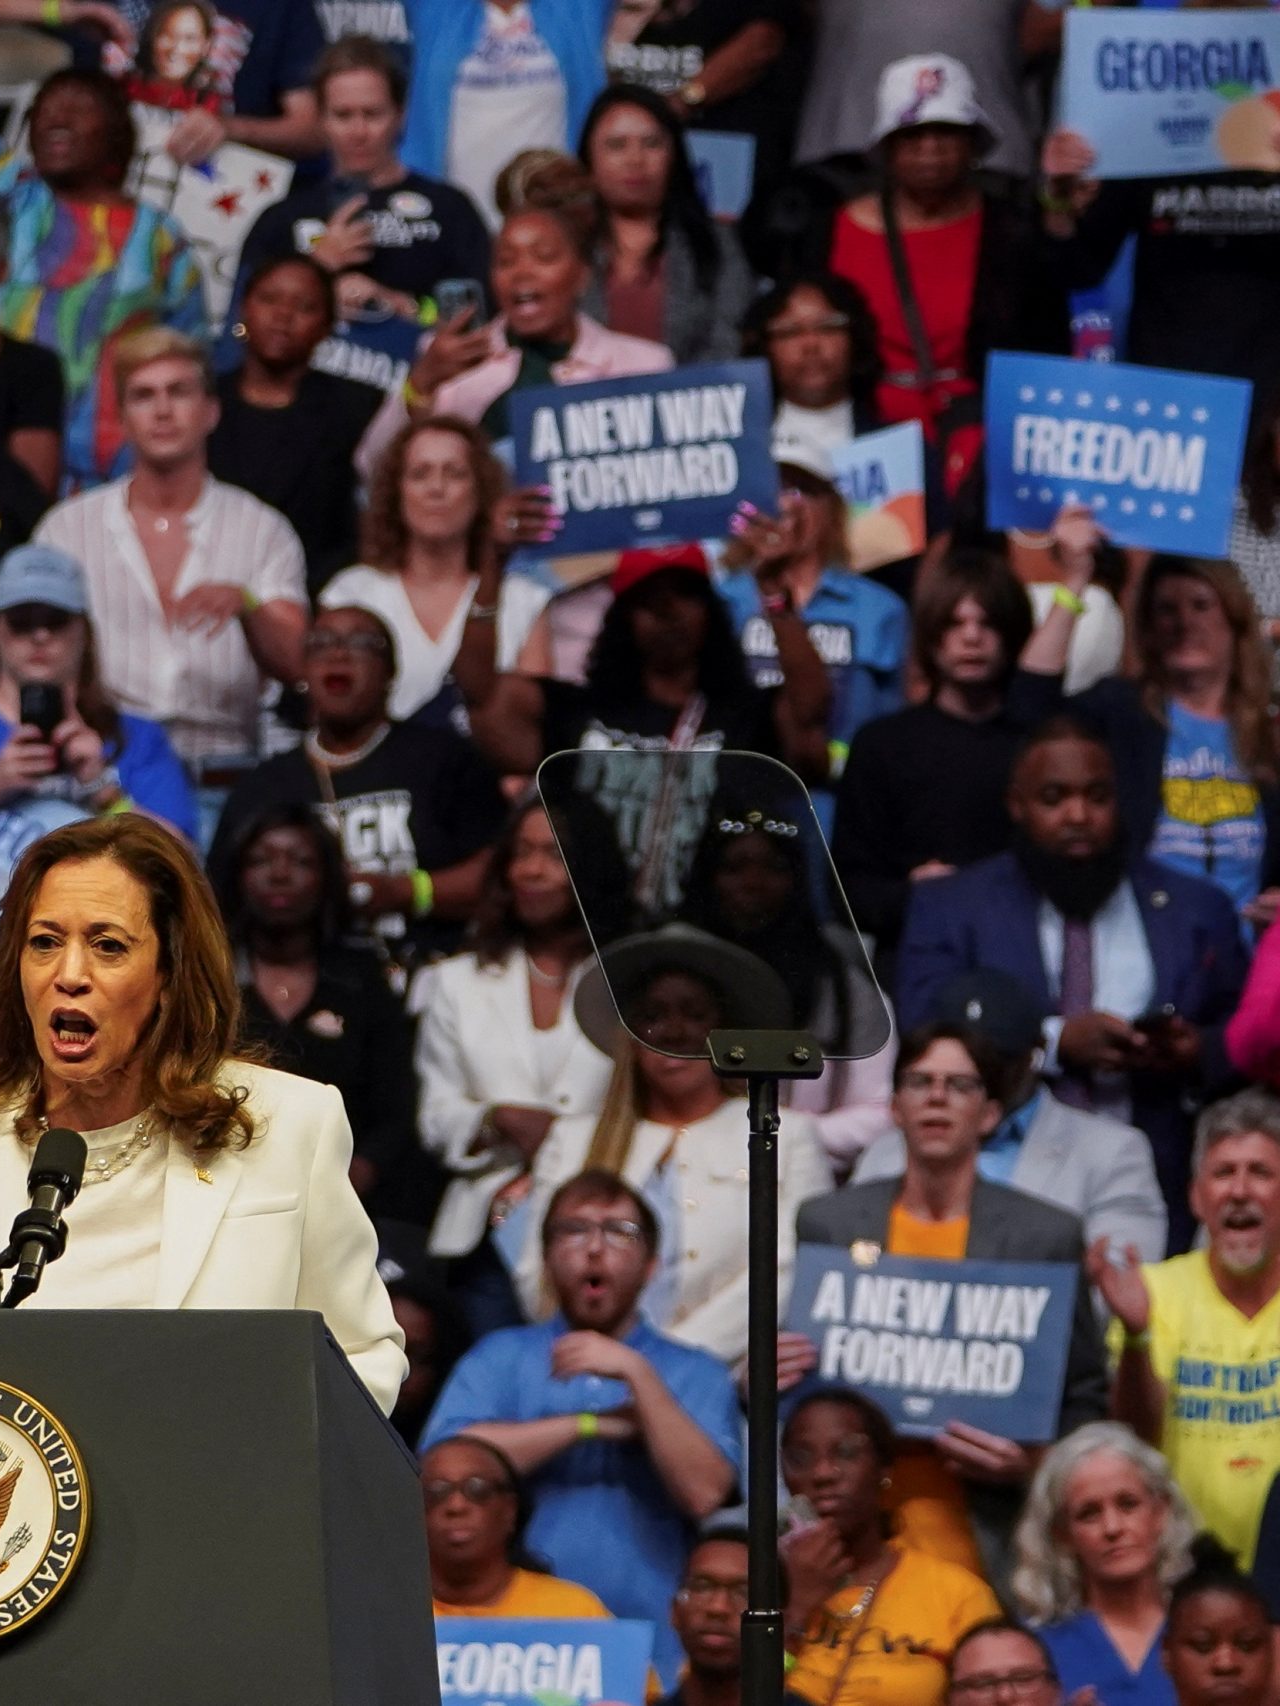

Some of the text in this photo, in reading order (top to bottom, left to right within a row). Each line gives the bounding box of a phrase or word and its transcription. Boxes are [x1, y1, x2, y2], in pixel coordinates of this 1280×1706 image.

[1097, 38, 1273, 91] GEORGIA
[531, 383, 746, 462] A NEW WAY
[1013, 413, 1206, 496] FREEDOM
[548, 440, 739, 516] FORWARD
[811, 1269, 1051, 1343] A NEW WAY
[820, 1325, 1024, 1397] FORWARD
[13, 1401, 81, 1511] UNITED
[437, 1641, 605, 1700] EORGIA
